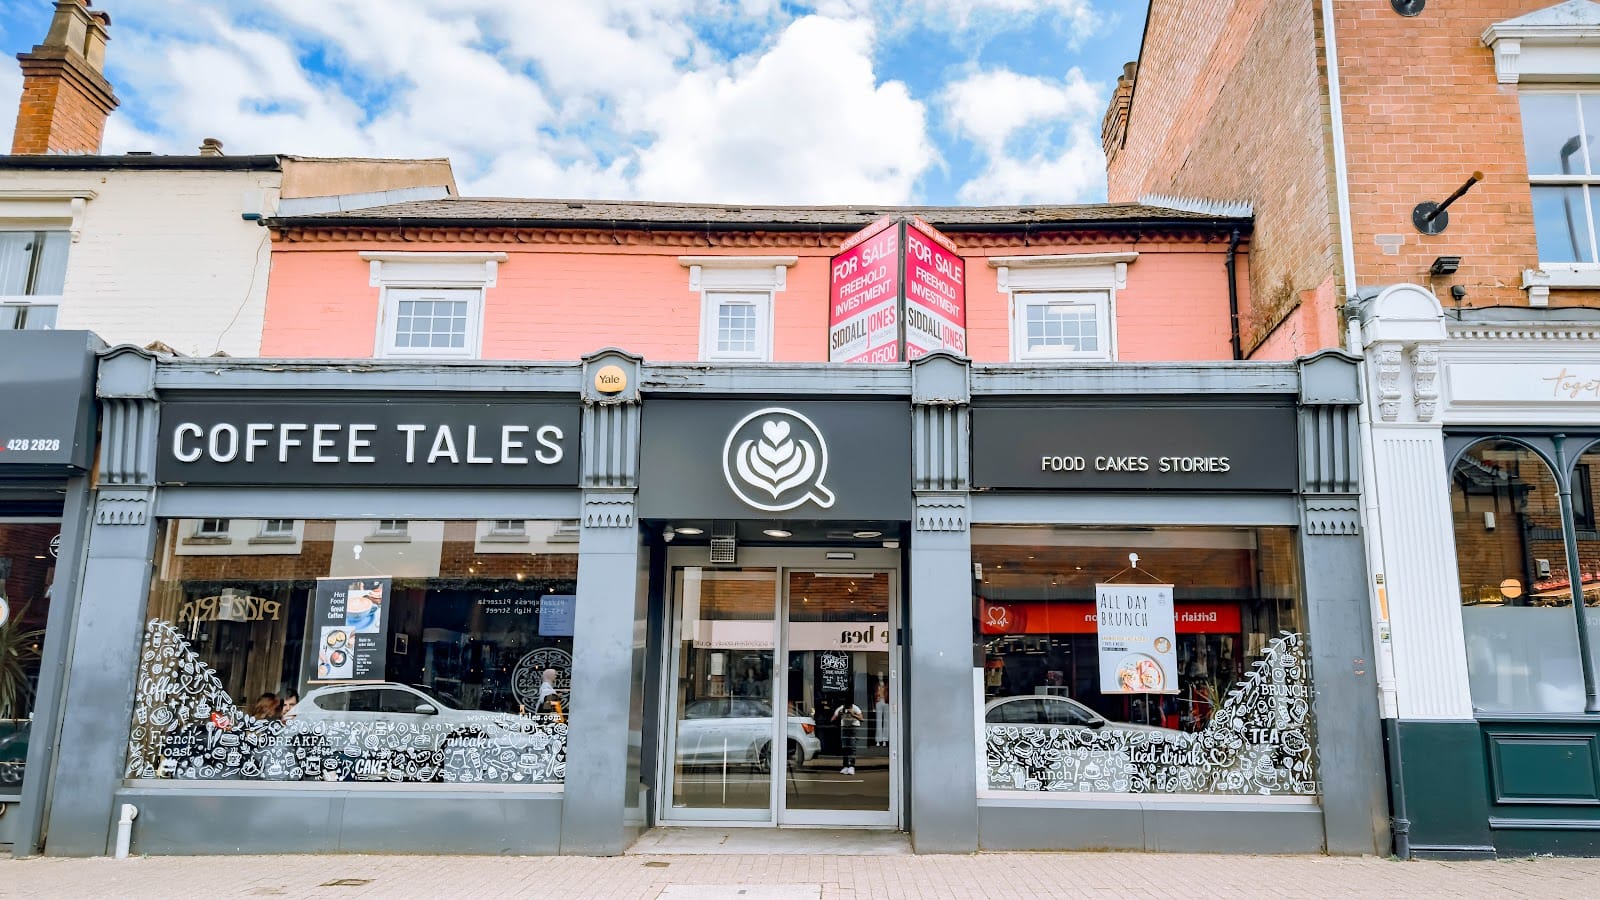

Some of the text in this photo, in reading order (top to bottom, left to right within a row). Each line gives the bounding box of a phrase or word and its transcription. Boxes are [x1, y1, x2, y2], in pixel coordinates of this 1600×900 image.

[833, 256, 858, 284] FOR
[862, 234, 897, 267] SALE
[908, 236, 962, 285] FOR SALE
[839, 265, 887, 299] FREEHOLD
[915, 266, 956, 300] FREEHOLD
[835, 279, 892, 317] INVESTMENT
[911, 281, 960, 318] INVESTMENT
[832, 318, 867, 350] SIDDALL
[866, 305, 895, 349] JONES
[908, 307, 942, 340] SIDDALL
[942, 324, 964, 352] JONES
[599, 375, 620, 384] Yale
[7, 439, 60, 451] 428 2828
[172, 422, 564, 465] COFFEE TALES
[1041, 456, 1231, 473] FOOD CAKES STORIES
[1101, 593, 1121, 609] ALL
[1127, 595, 1147, 610] DAY
[1101, 611, 1148, 627] BRUNCH
[143, 676, 184, 701] Coffee
[1260, 684, 1309, 698] BRUNCH
[150, 730, 197, 746] French
[268, 736, 343, 747] BREAKFAST
[434, 731, 501, 756] Pancakes
[1249, 728, 1279, 744] TEA
[156, 744, 193, 757] Toast
[1129, 742, 1211, 772] Iced drinks
[355, 759, 388, 775] CAKE
[1025, 765, 1073, 780] Lunch
